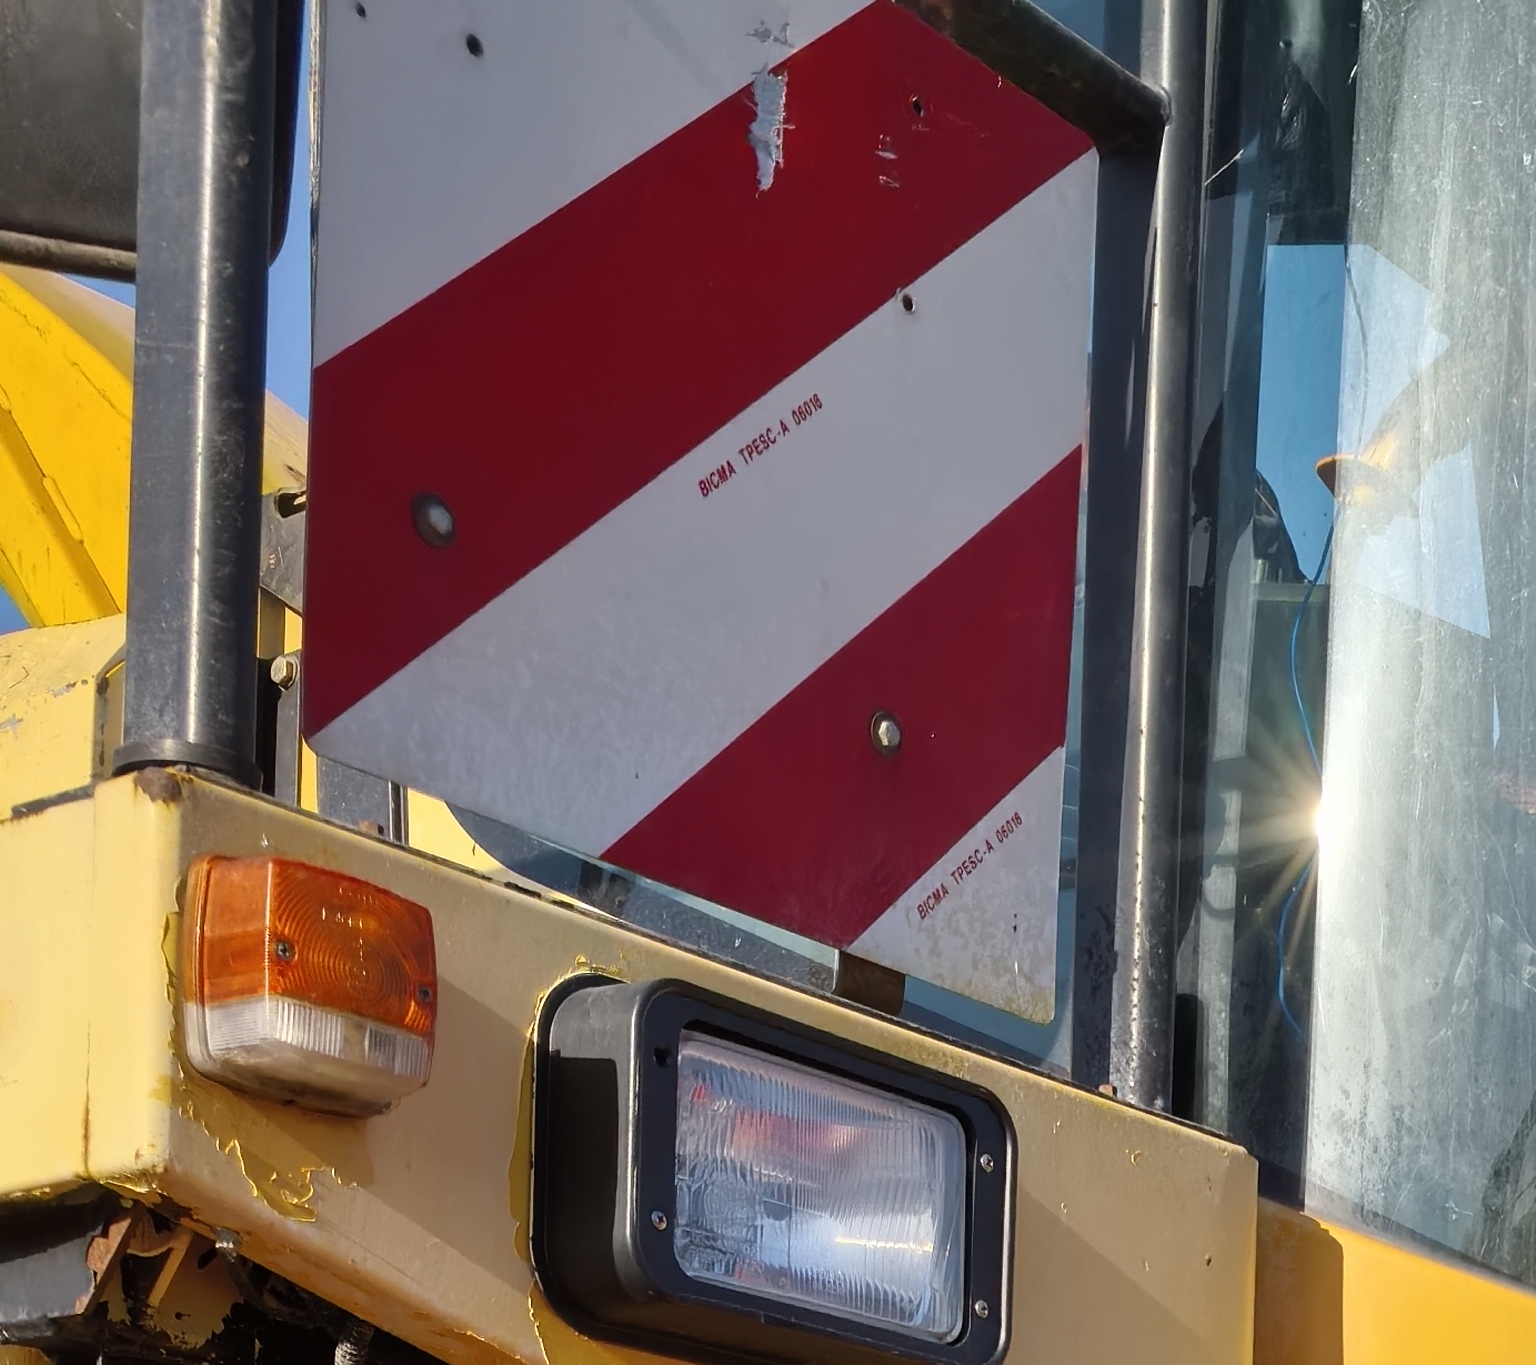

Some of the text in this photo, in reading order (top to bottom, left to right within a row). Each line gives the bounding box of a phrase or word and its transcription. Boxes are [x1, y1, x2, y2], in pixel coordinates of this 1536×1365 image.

[698, 460, 737, 498] BICMA
[738, 419, 791, 465] TPESC-A
[916, 883, 949, 920] BICMA
[950, 839, 994, 885] TPESC-A
